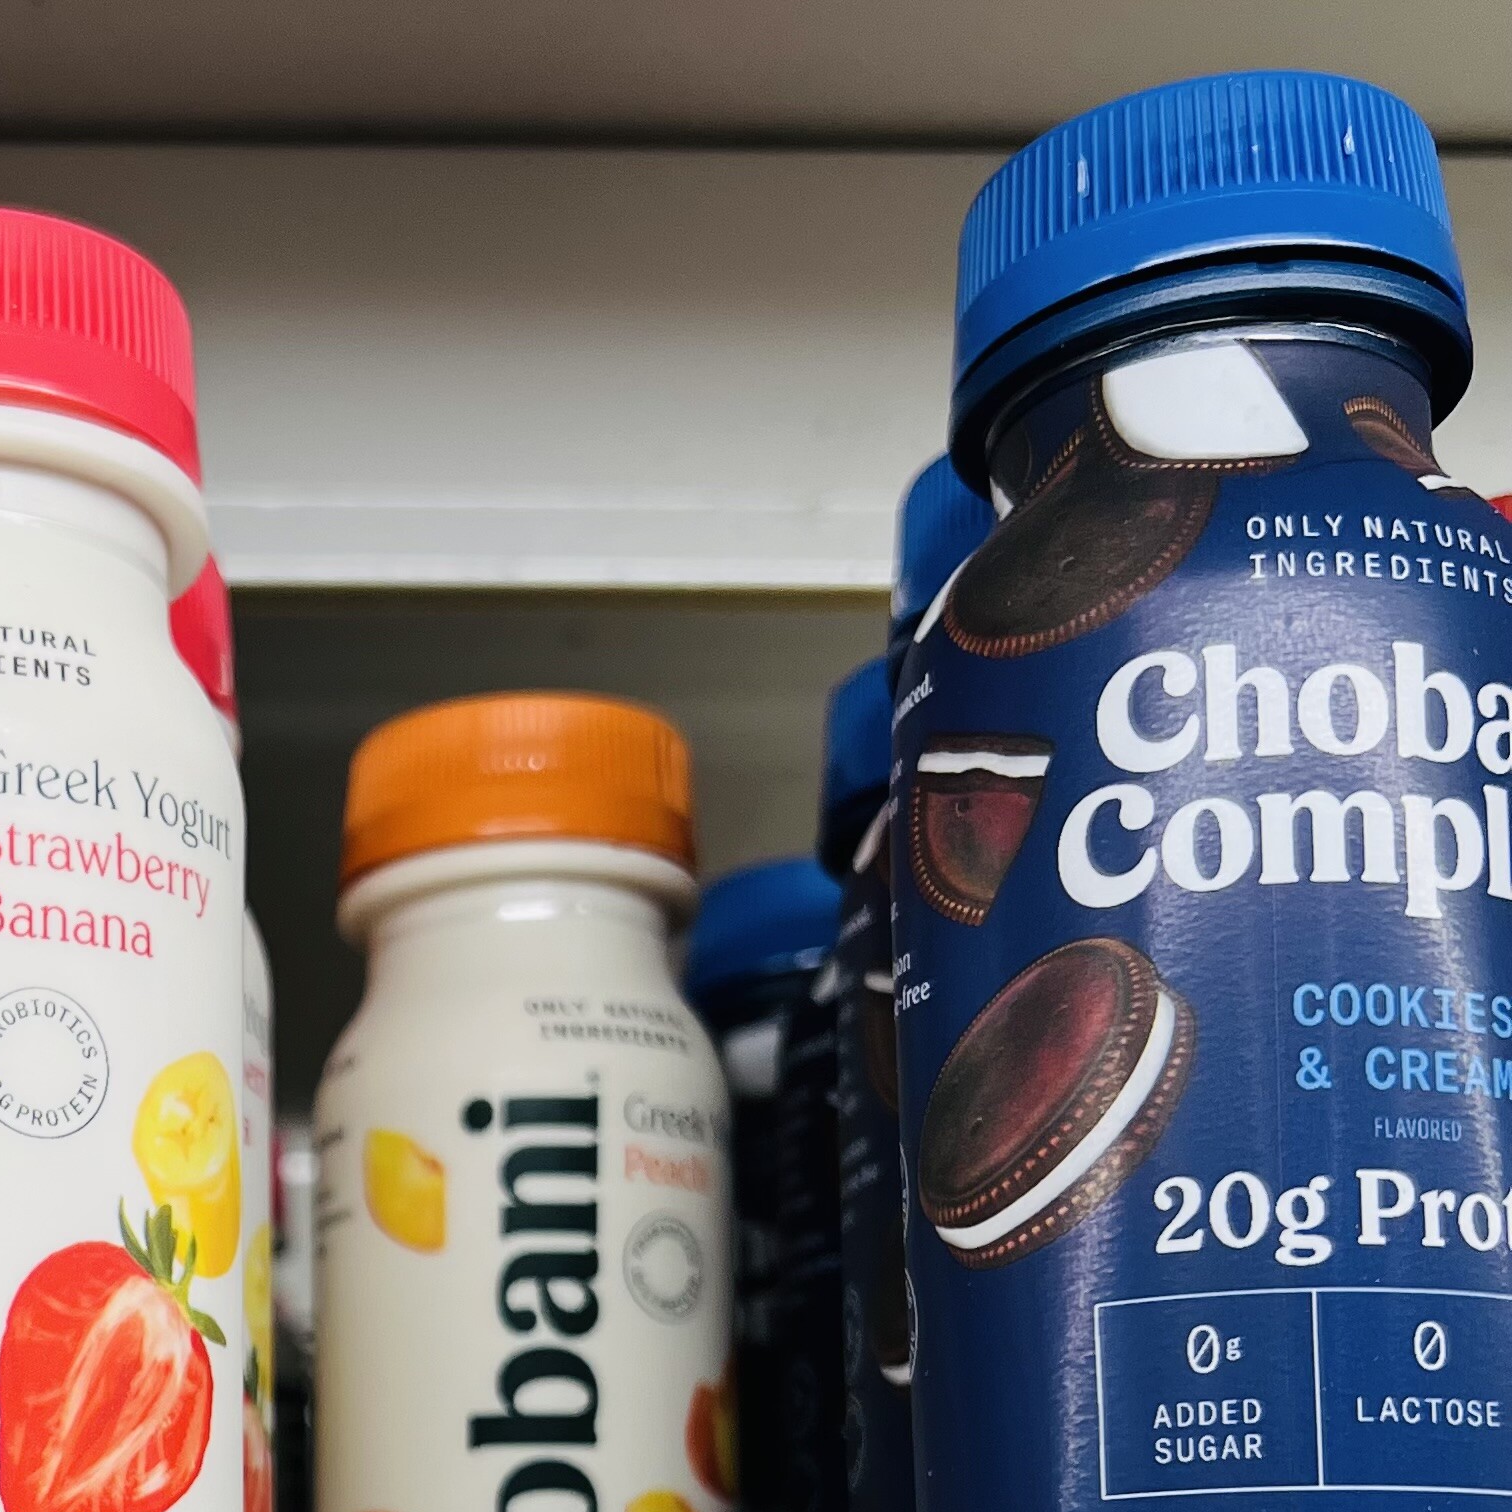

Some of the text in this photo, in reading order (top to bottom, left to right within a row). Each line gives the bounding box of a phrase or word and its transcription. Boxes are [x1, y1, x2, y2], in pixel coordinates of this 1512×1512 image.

[1247, 514, 1512, 565] ONLY NATURAL
[1249, 551, 1512, 604] INGREDIENTS
[133, 770, 232, 860] Yogurt
[1293, 983, 1512, 1039] COOKIES
[1296, 1046, 1512, 1101] & CREAM
[1375, 1116, 1464, 1142] FLAVORED
[1153, 1168, 1512, 1267] 20g Pro
[1413, 1320, 1448, 1371] 0
[1153, 1398, 1264, 1429] ADDED
[1356, 1396, 1502, 1428] LACTOSE
[1154, 1433, 1264, 1465] SUGAR
